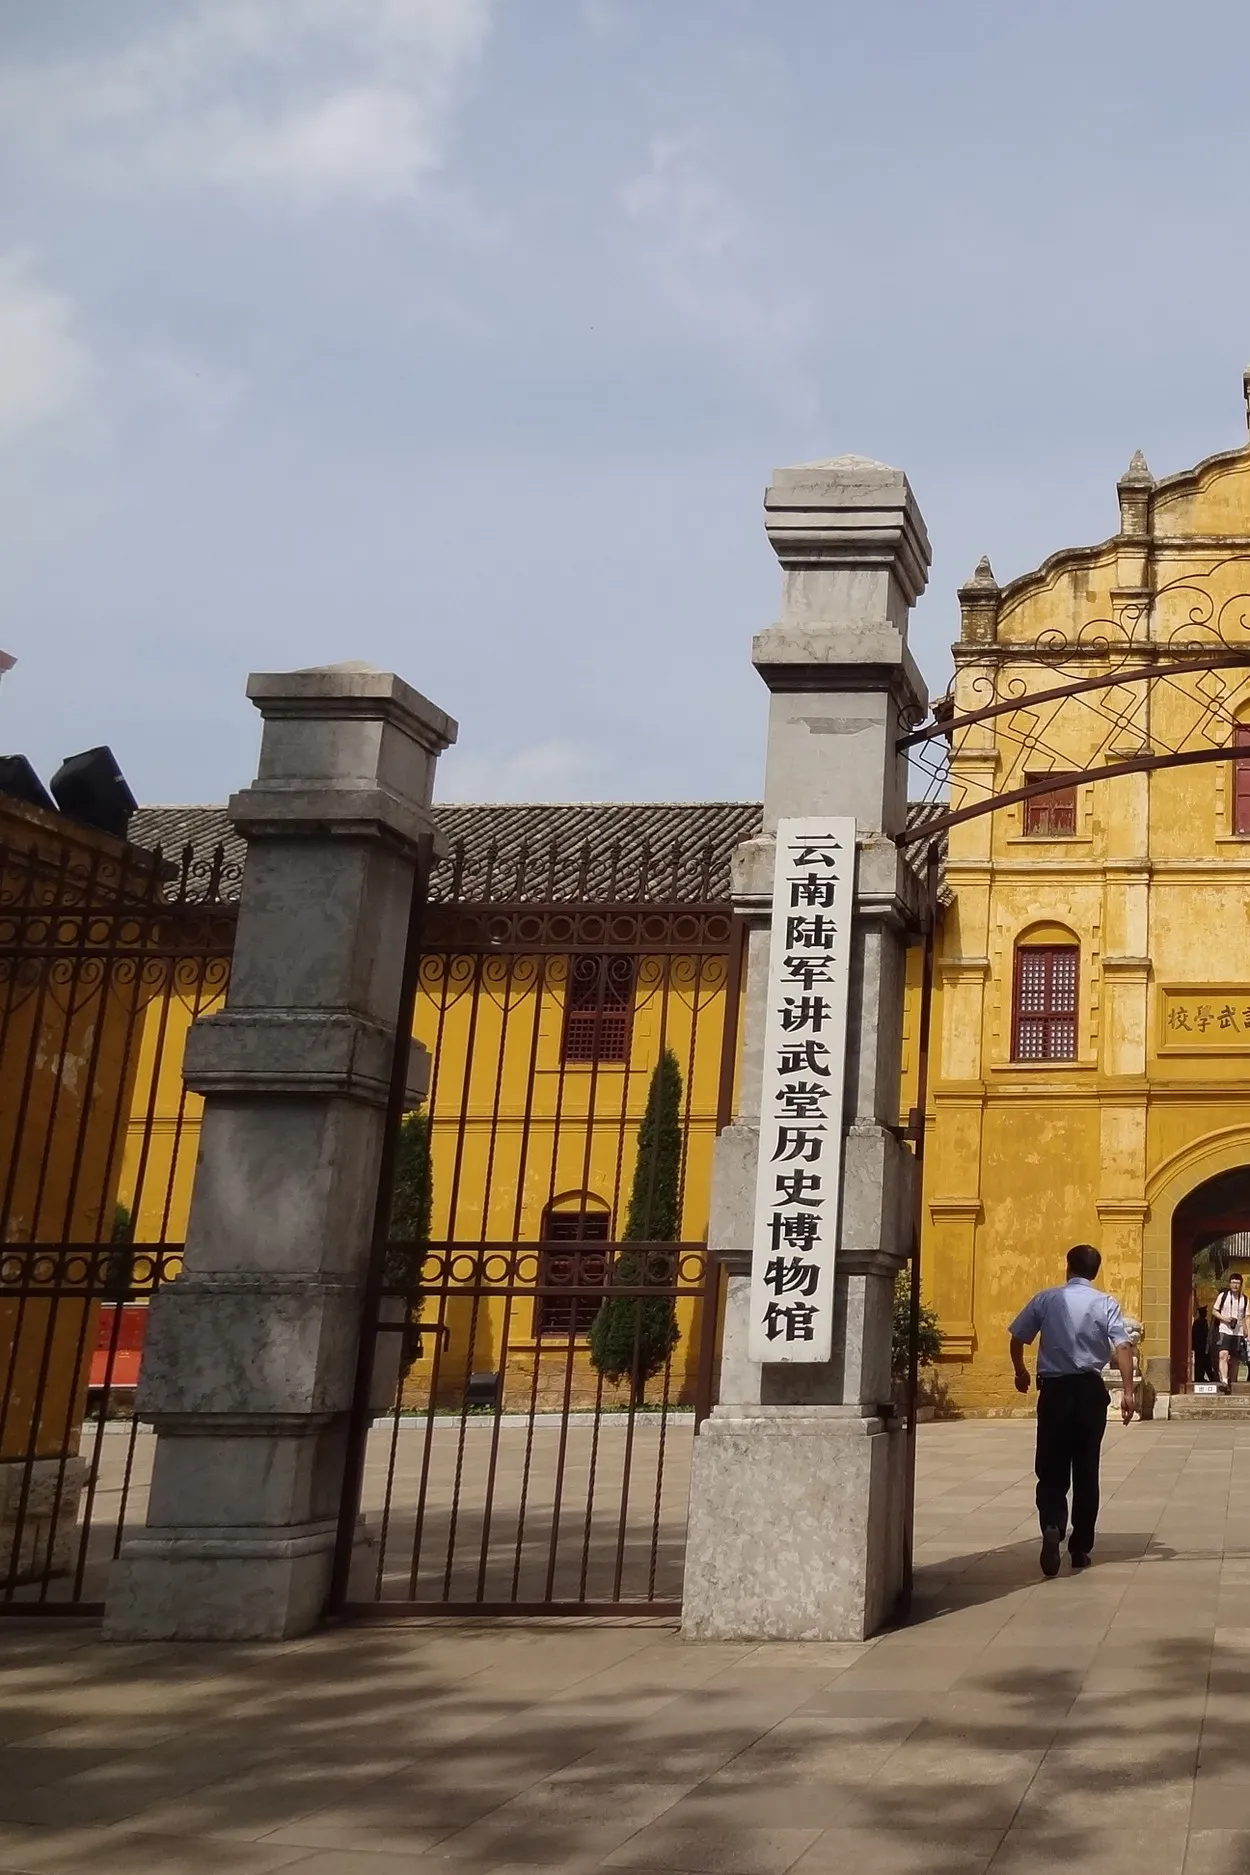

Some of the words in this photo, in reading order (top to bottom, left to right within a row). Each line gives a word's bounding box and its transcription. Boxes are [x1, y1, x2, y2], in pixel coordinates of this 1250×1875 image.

[760, 832, 844, 1342] 云南陆军讲武堂历史博物馆
